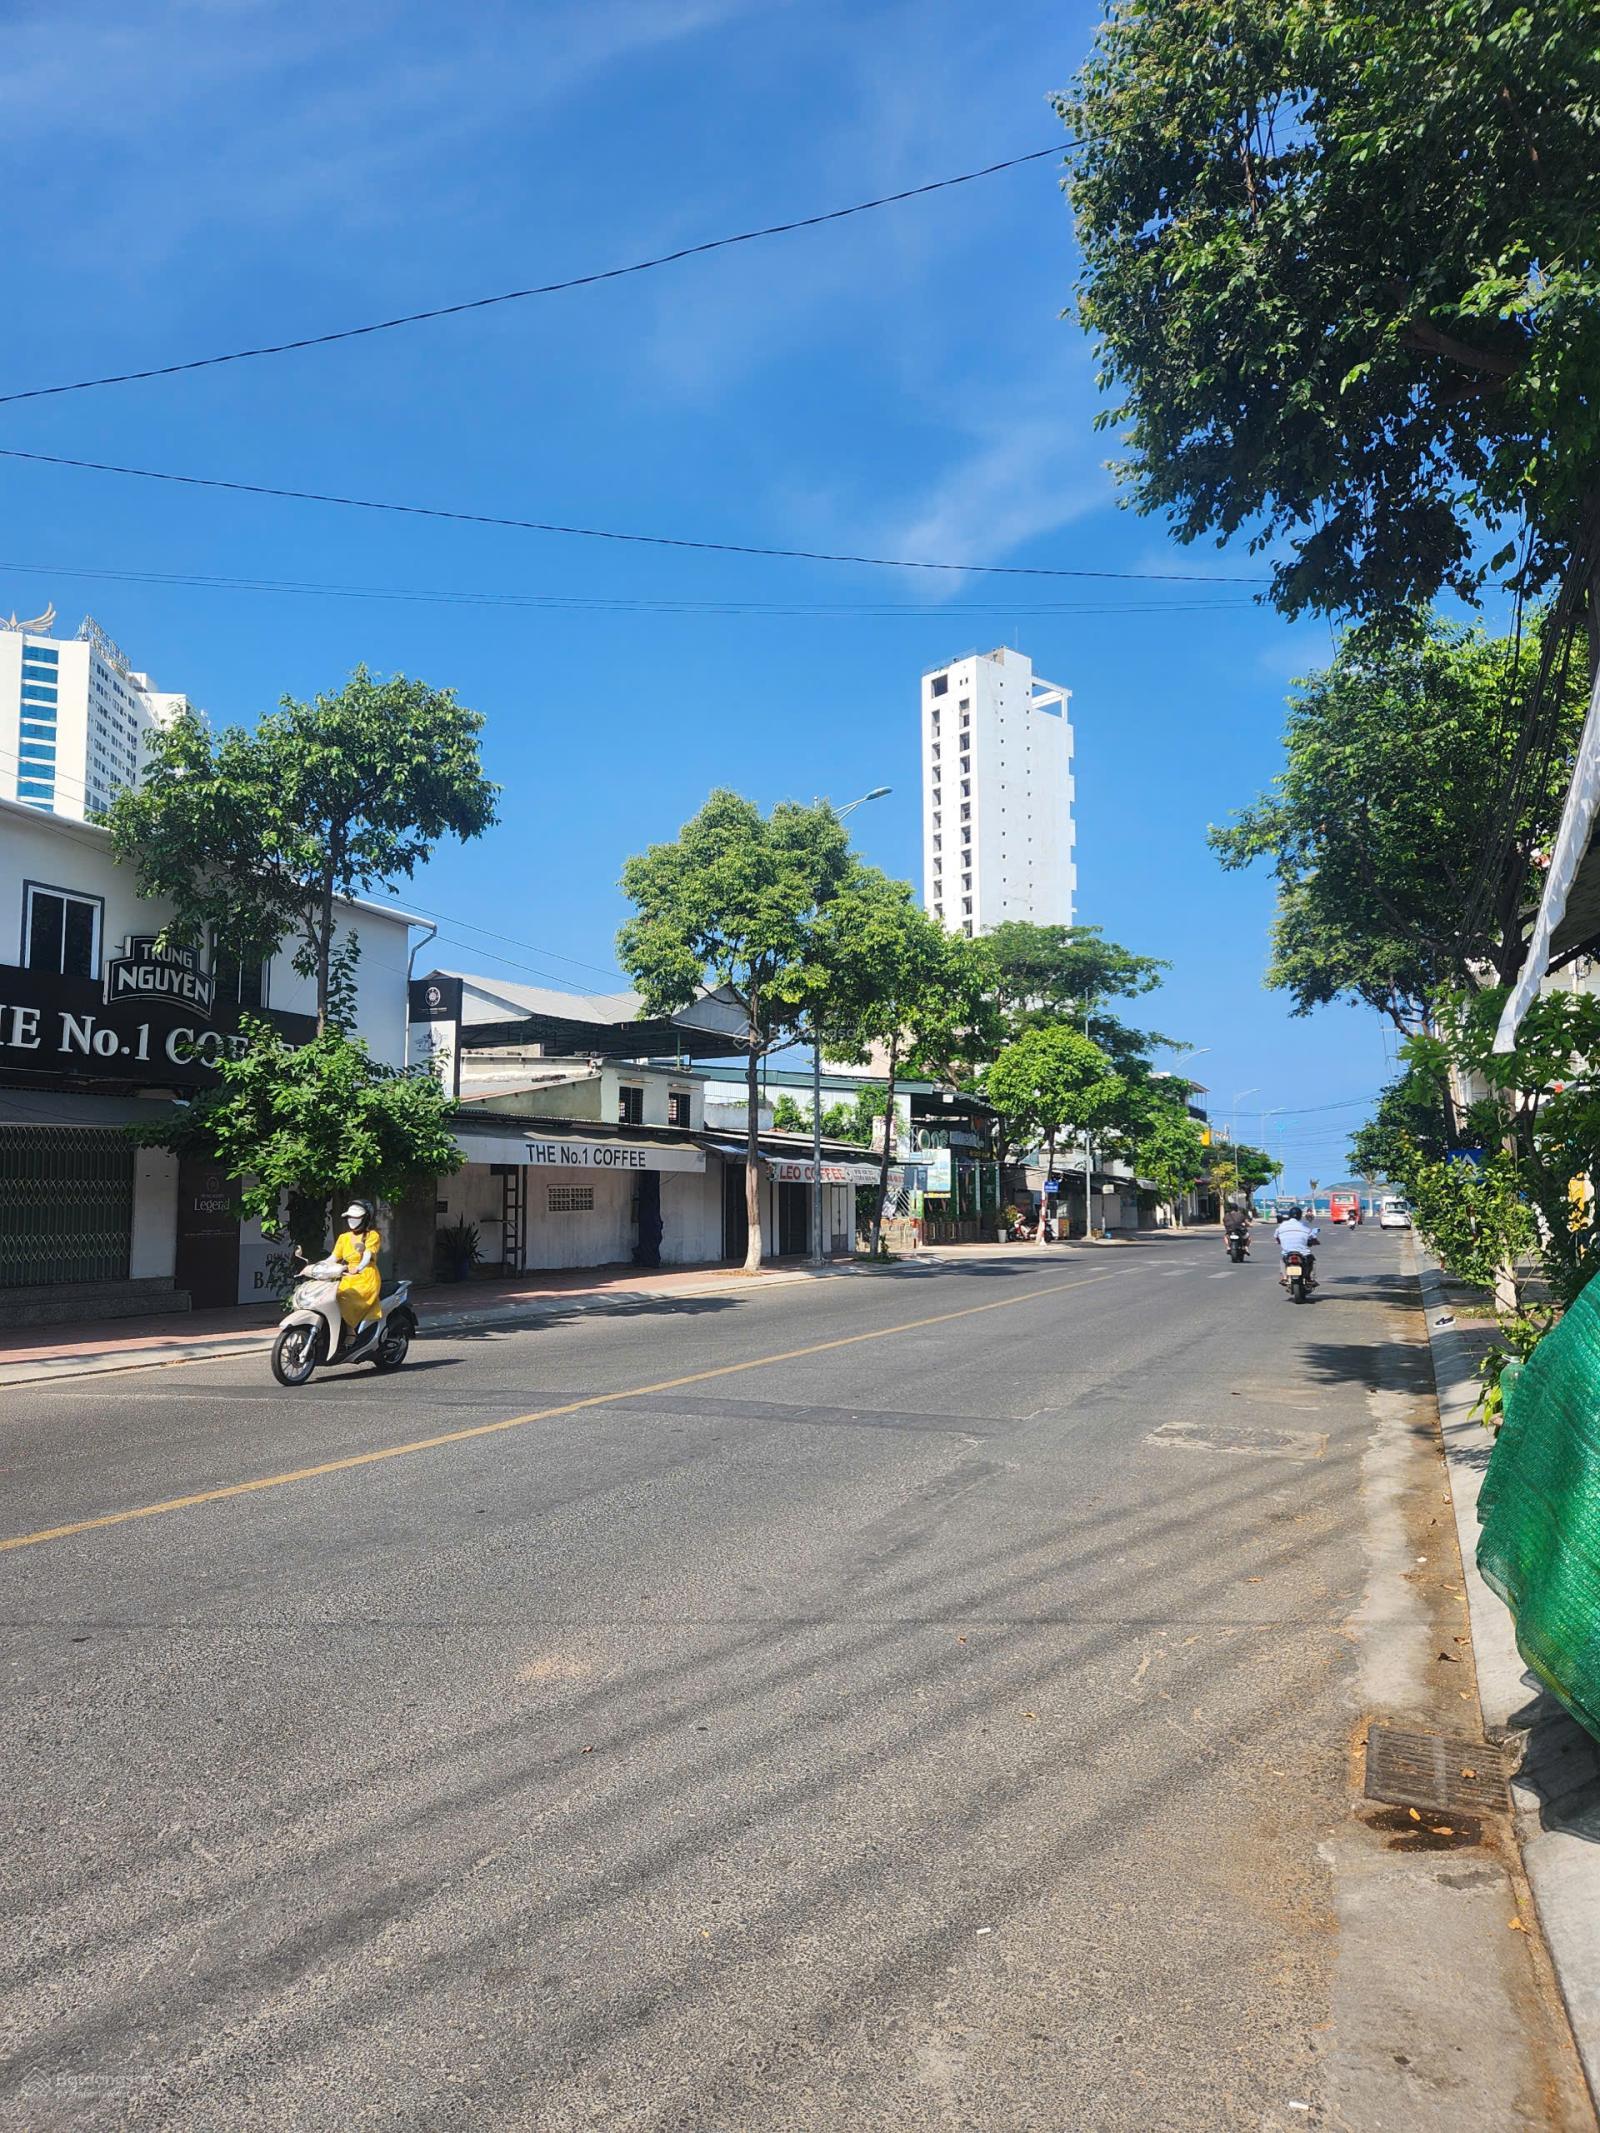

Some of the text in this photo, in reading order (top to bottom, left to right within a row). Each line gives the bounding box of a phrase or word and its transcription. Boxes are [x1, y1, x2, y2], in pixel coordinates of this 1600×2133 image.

[118, 965, 209, 1005] NGUYÊN
[0, 1004, 41, 1049] E
[58, 1012, 151, 1061] No.1
[525, 1143, 646, 1168] THE No.1 COFFEE
[780, 1165, 801, 1180] LEO
